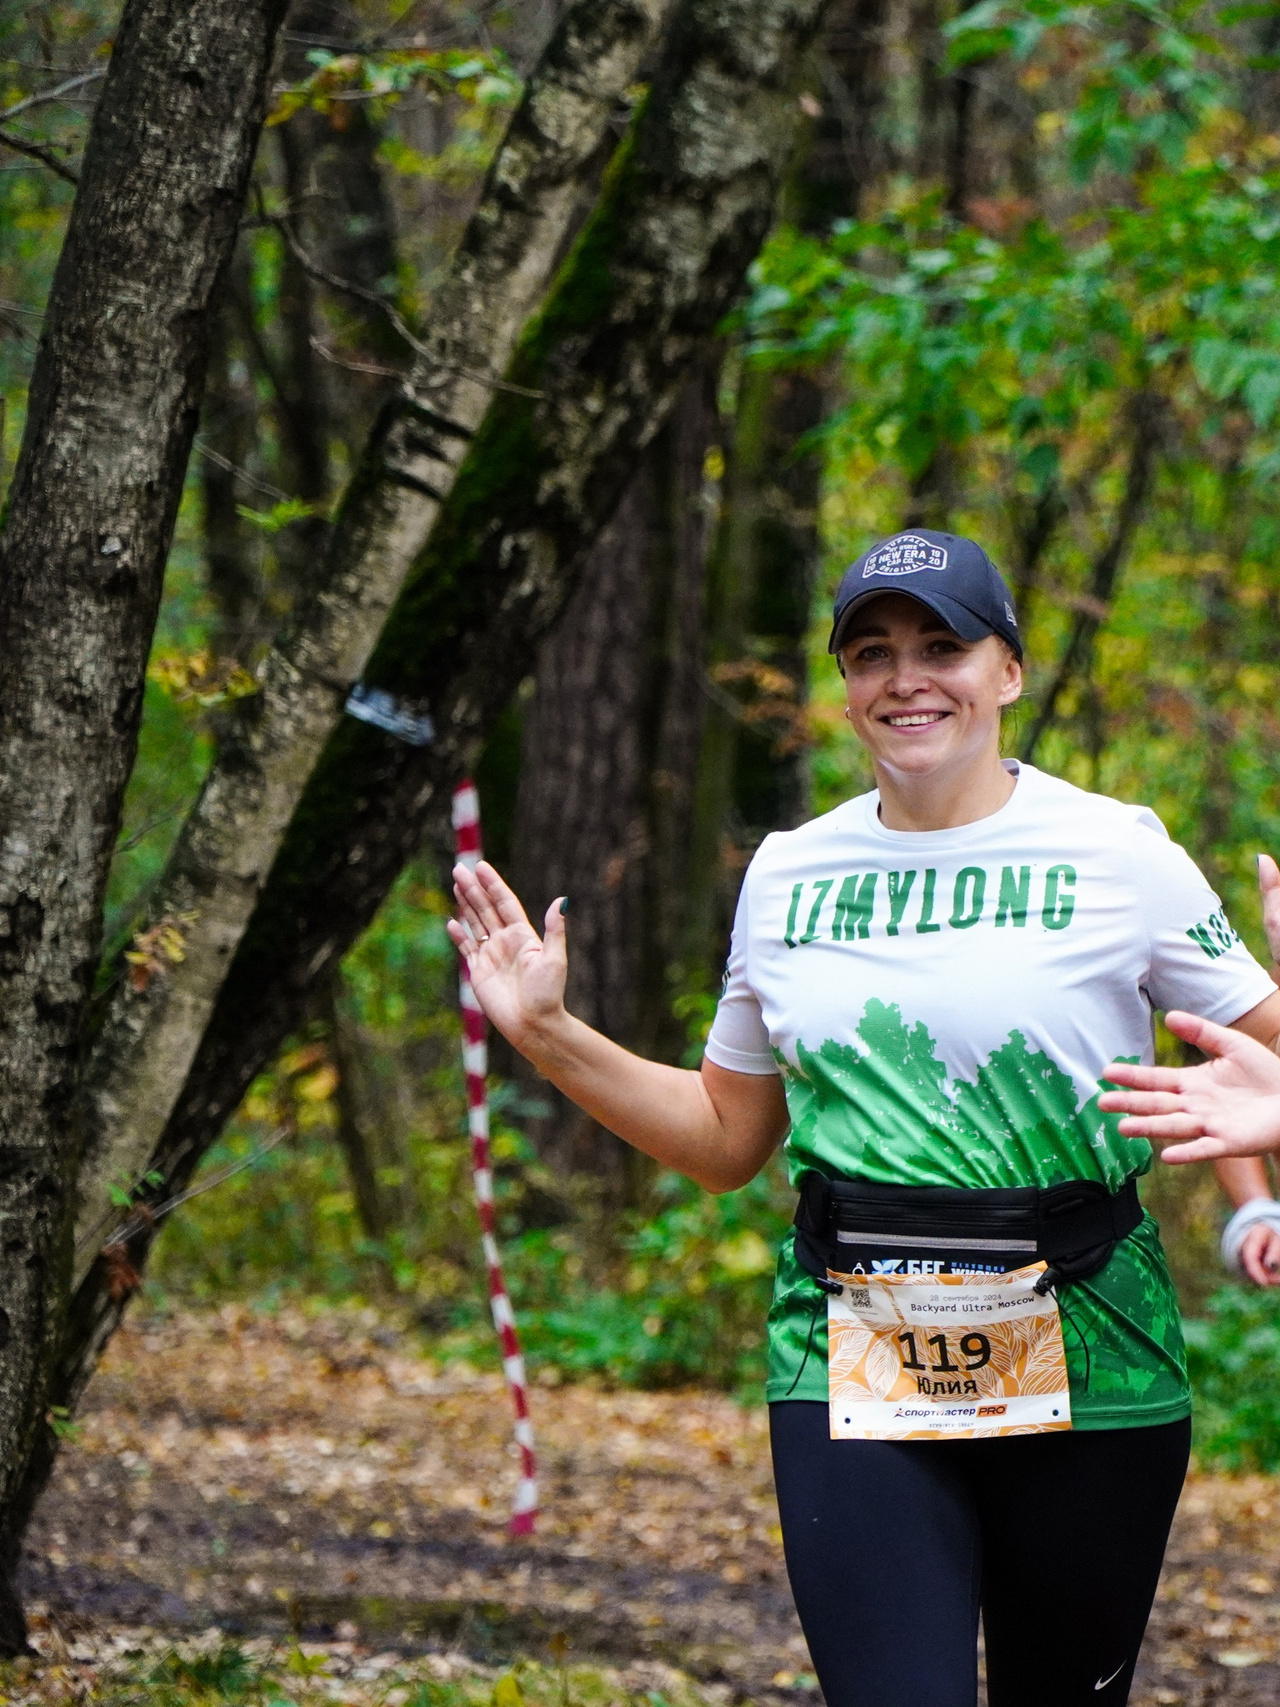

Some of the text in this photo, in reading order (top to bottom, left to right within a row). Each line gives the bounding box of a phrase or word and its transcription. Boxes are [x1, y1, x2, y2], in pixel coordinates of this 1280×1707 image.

[885, 537, 926, 551] BUFFALO
[878, 550, 926, 564] NEW ERA
[931, 549, 941, 558] 19
[879, 561, 924, 573] ORIGINAL
[886, 558, 902, 567] CAP
[928, 557, 941, 566] 20
[783, 863, 1078, 949] IZMYLONG
[910, 1296, 1035, 1313] Backyard Ultra Moscow
[983, 1294, 1002, 1302] 2024
[897, 1331, 993, 1373] 119
[917, 1376, 978, 1396] Юлия
[977, 1405, 1006, 1416] PRO
